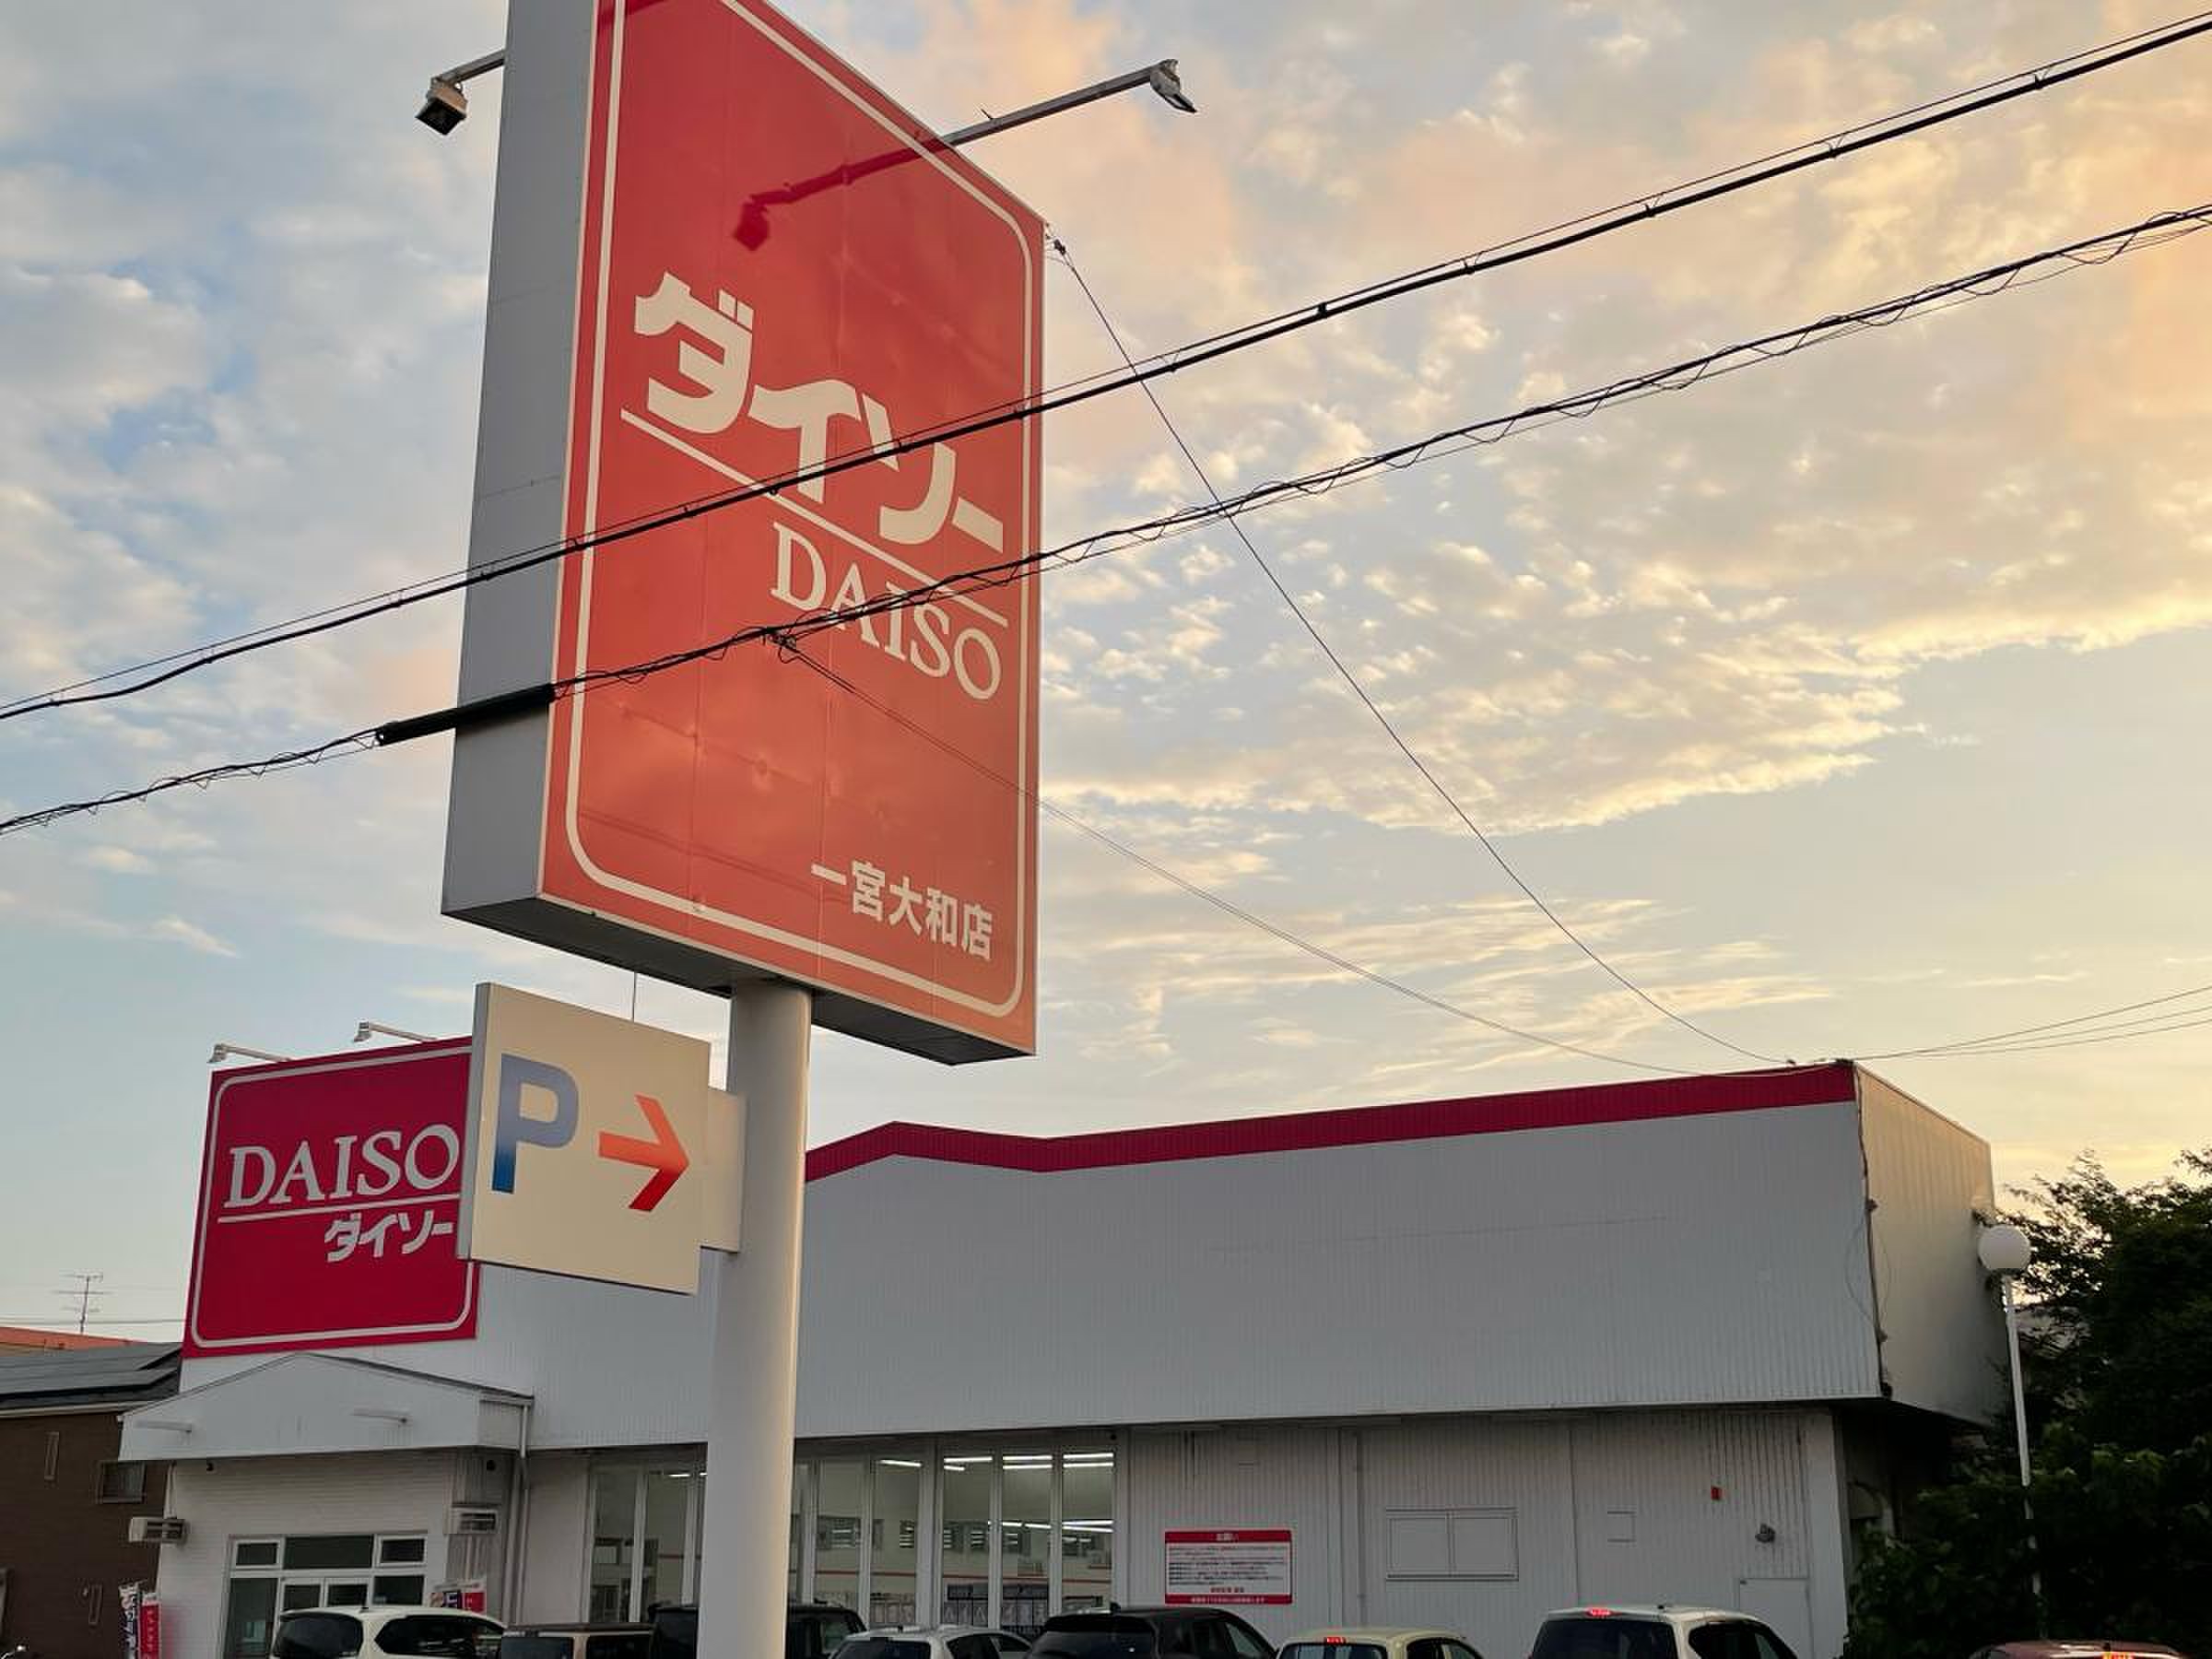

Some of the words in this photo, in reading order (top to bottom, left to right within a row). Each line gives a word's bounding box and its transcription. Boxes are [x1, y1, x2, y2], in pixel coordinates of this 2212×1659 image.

[634, 272, 1003, 552] ダイソー
[771, 522, 1002, 700] DAISO
[811, 860, 993, 959] 一宮大和店
[224, 1124, 459, 1208] DAISO
[492, 1053, 579, 1194] P
[324, 1211, 453, 1262] ダイソー
